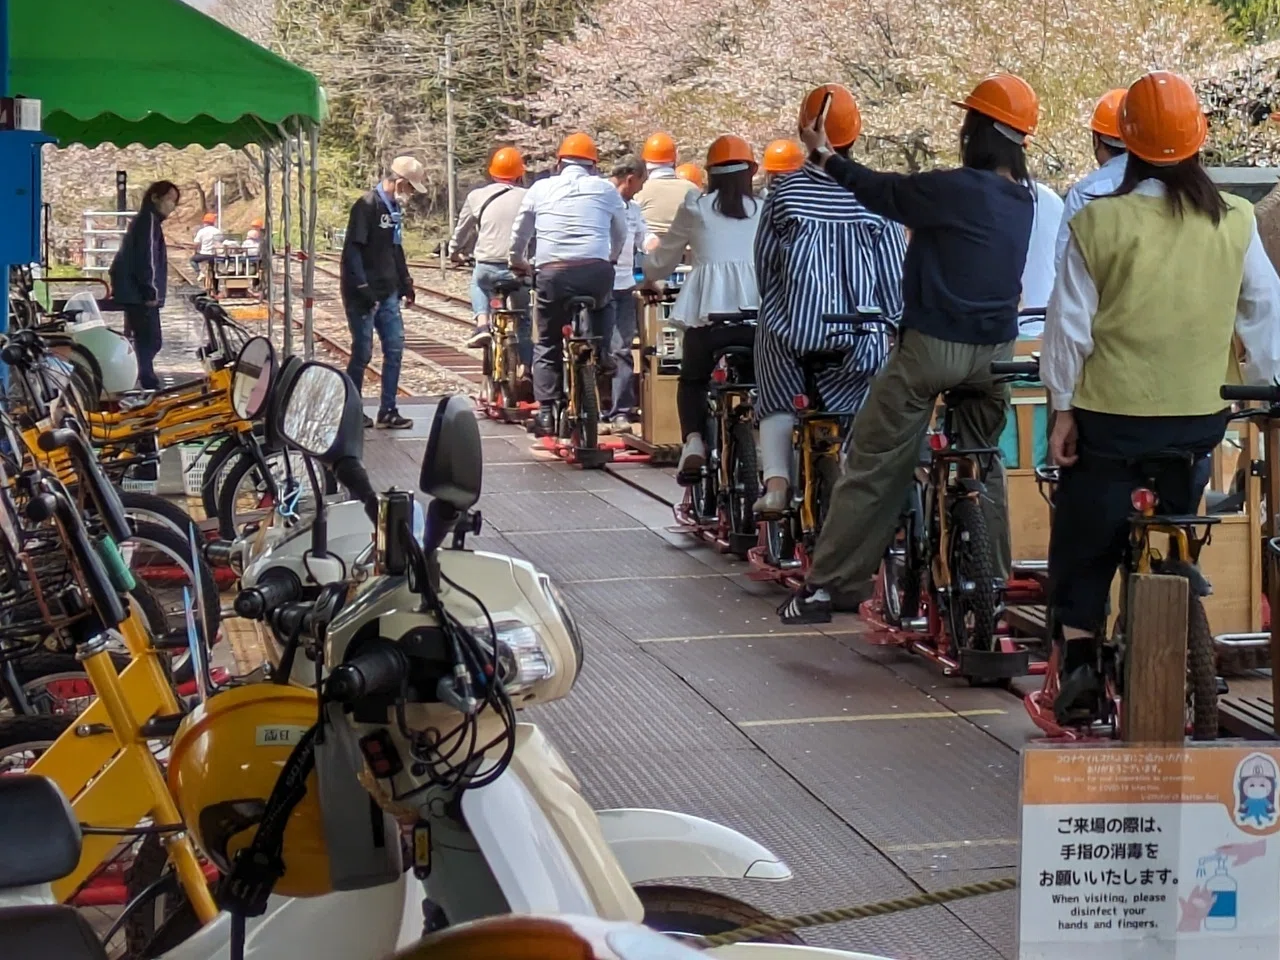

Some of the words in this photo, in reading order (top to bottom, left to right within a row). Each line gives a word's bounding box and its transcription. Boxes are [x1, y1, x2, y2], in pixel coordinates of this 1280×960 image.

[1058, 816, 1162, 834] ご来場の際は、
[1060, 843, 1159, 860] 手指の消毒を
[1039, 868, 1179, 887] お願いいたします。
[1052, 894, 1079, 903] When
[1085, 893, 1127, 905] visiting,
[1133, 893, 1166, 904] please
[1071, 906, 1117, 916] disinfect
[1123, 907, 1146, 917] your
[1058, 920, 1088, 929] hands
[1094, 920, 1112, 929] and
[1118, 919, 1158, 930] fingers.
